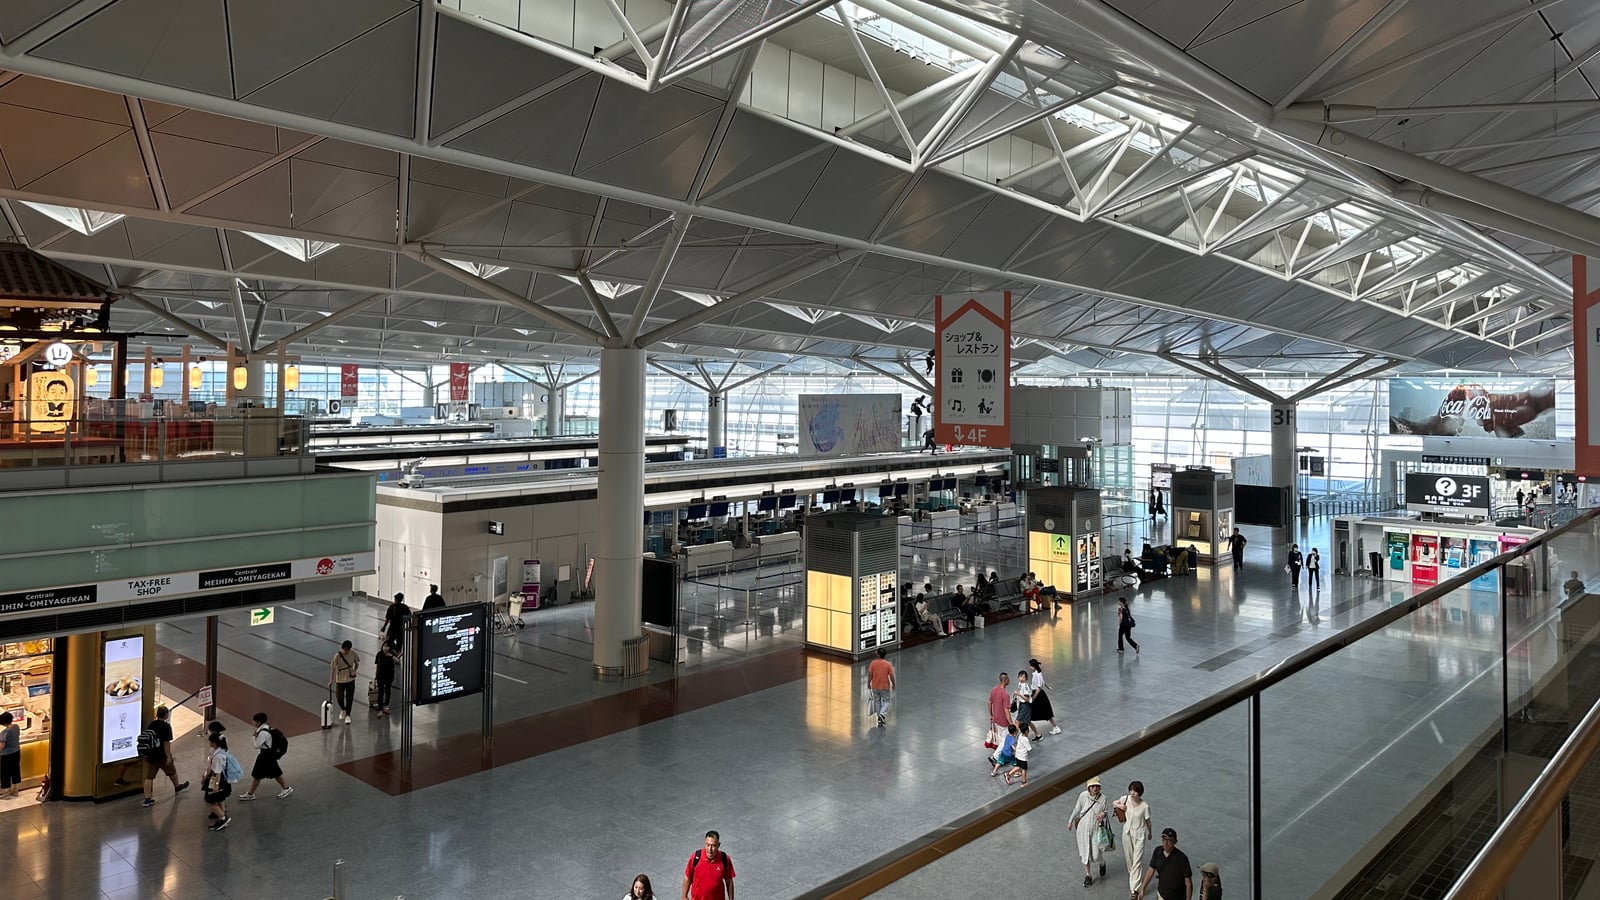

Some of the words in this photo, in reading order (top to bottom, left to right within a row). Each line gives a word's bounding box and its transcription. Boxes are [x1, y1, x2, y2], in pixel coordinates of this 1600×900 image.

[945, 331, 982, 343] ショップ&
[957, 343, 999, 355] レストラン
[440, 404, 449, 418] N
[470, 406, 480, 419] M
[667, 412, 676, 428] K
[967, 428, 987, 443] 4F
[1461, 484, 1482, 498] 3F
[234, 568, 258, 576] Centrair
[128, 577, 171, 589] TAX-FREE
[204, 571, 286, 587] MEIHIN-OMIYAGEKAN
[25, 592, 55, 601] Centrair
[137, 587, 162, 597] SHOP
